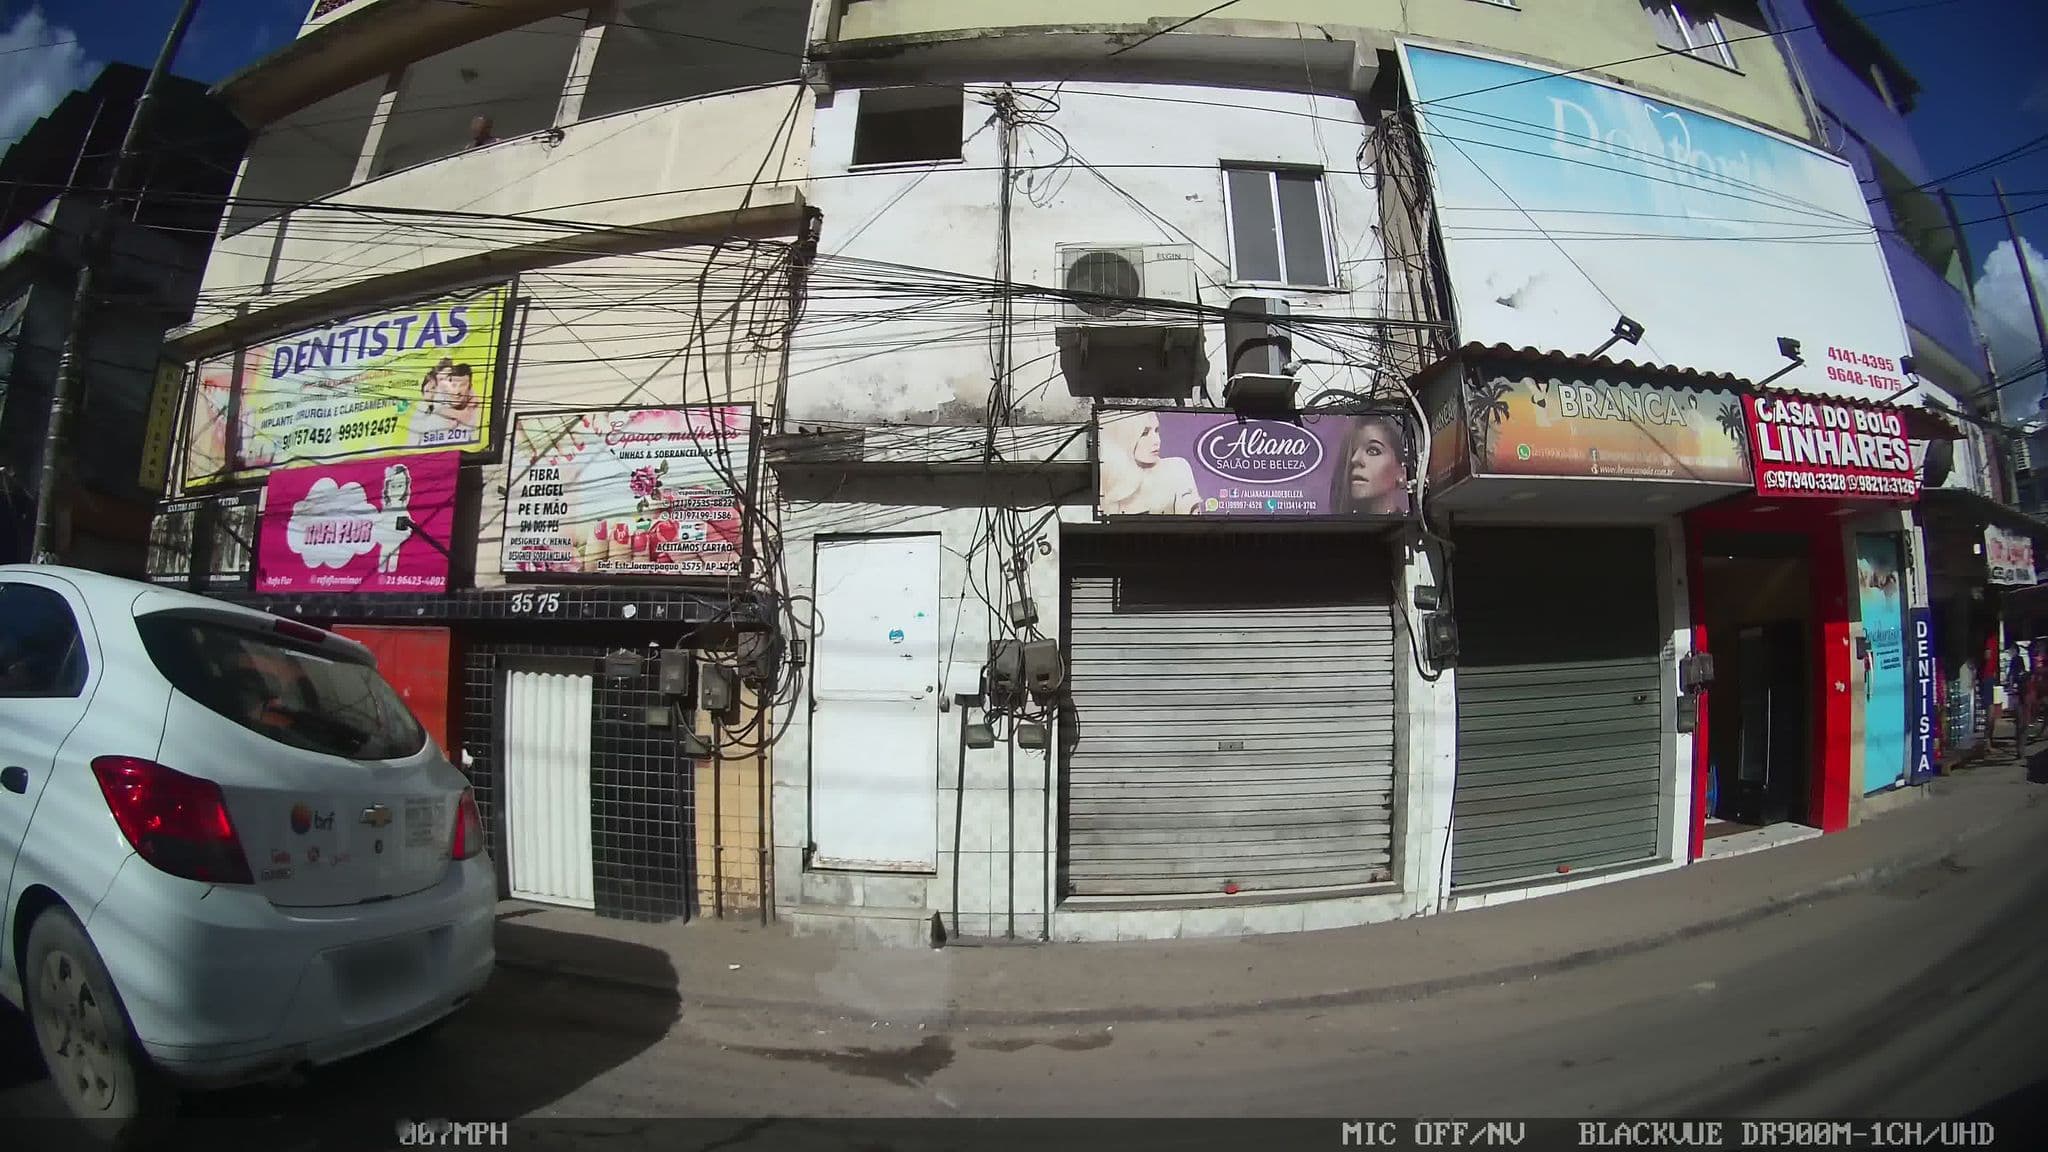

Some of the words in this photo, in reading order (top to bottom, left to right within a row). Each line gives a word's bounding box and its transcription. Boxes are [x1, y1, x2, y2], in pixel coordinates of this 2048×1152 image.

[1157, 253, 1181, 261] ELGIN
[271, 306, 470, 379] DENTISTAS
[1828, 346, 1894, 372] 4141-4395
[1557, 384, 1687, 426] BRANCA
[1755, 397, 1819, 427] CASA
[1821, 405, 1849, 429] DO
[1853, 409, 1900, 436] BOLO
[338, 416, 399, 441] 993312437
[423, 431, 445, 442] Sala
[447, 428, 468, 440] 201
[604, 421, 663, 448] Espaço
[667, 426, 741, 442] mulheres
[1209, 427, 1310, 458] Aliana
[1755, 422, 1911, 472] LINHARES
[619, 451, 645, 460] UNHAS
[1216, 457, 1251, 469] SALÃO
[1253, 459, 1267, 469] DE
[1269, 460, 1306, 470] BELEZA
[529, 468, 560, 481] FIBRA
[521, 484, 564, 498] ACRIGEL
[534, 503, 541, 515] E
[543, 499, 568, 515] MÃO
[510, 538, 540, 546] DESIGNER
[657, 543, 700, 552] ACEITAMOS
[681, 562, 702, 571] 3575
[1915, 620, 1931, 773] DENTISTA
[314, 809, 336, 831] brf
